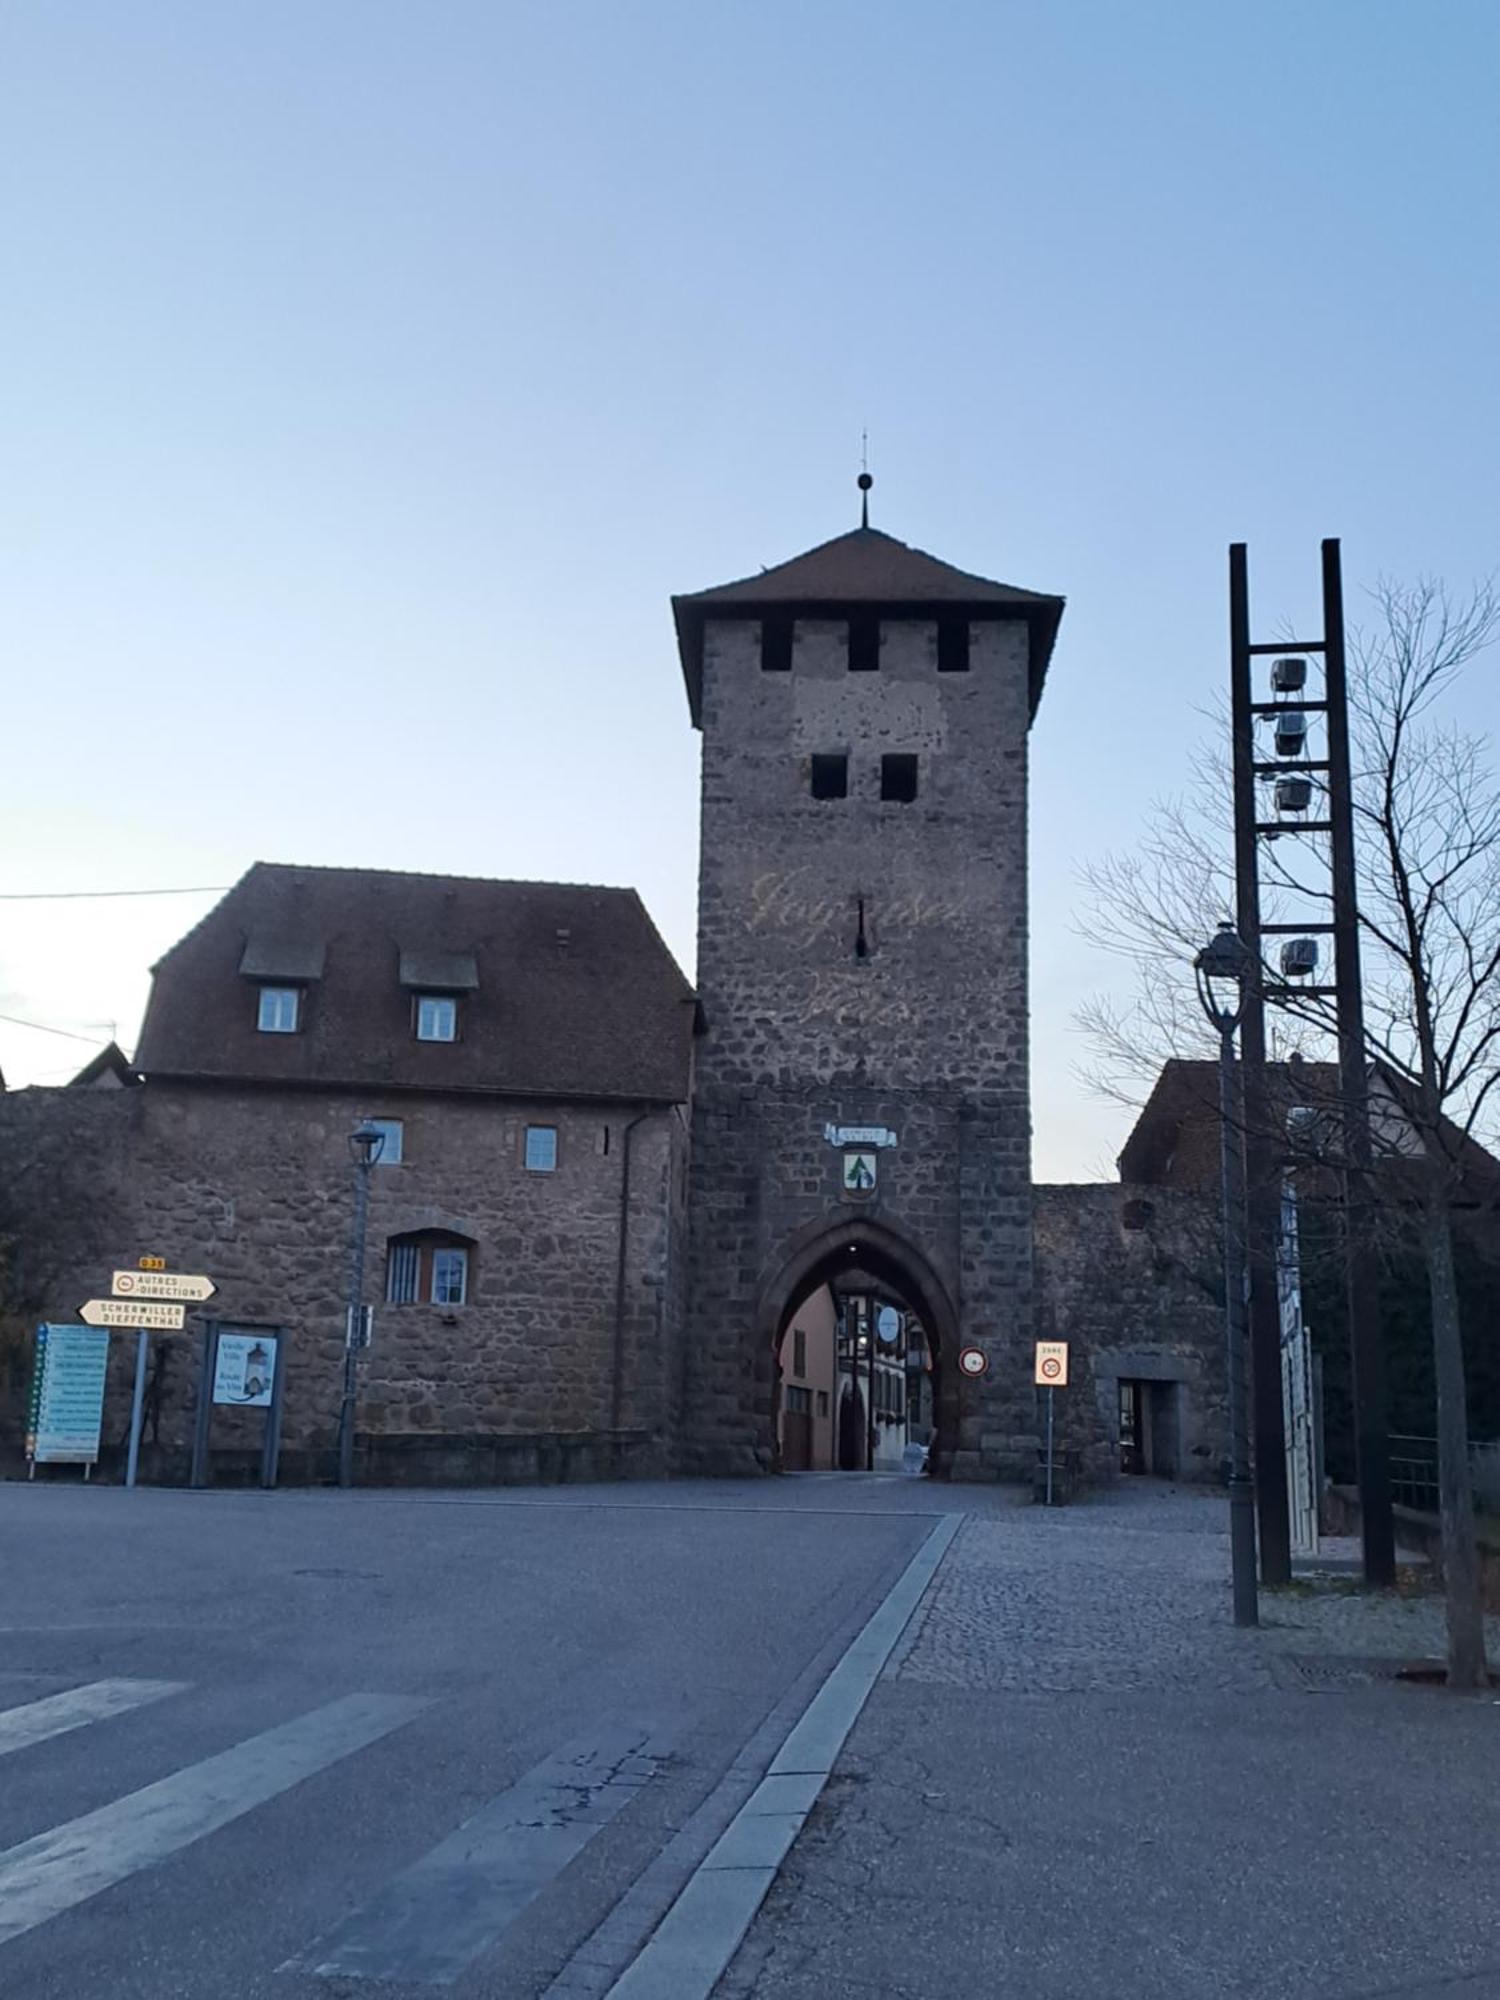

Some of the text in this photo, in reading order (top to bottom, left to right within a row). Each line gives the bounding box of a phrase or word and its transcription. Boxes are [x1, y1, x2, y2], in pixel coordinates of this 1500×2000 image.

[138, 1276, 178, 1286] AUTRES
[101, 1303, 181, 1314] SCHERWILLER
[103, 1315, 180, 1326] DIEFFENTHAL
